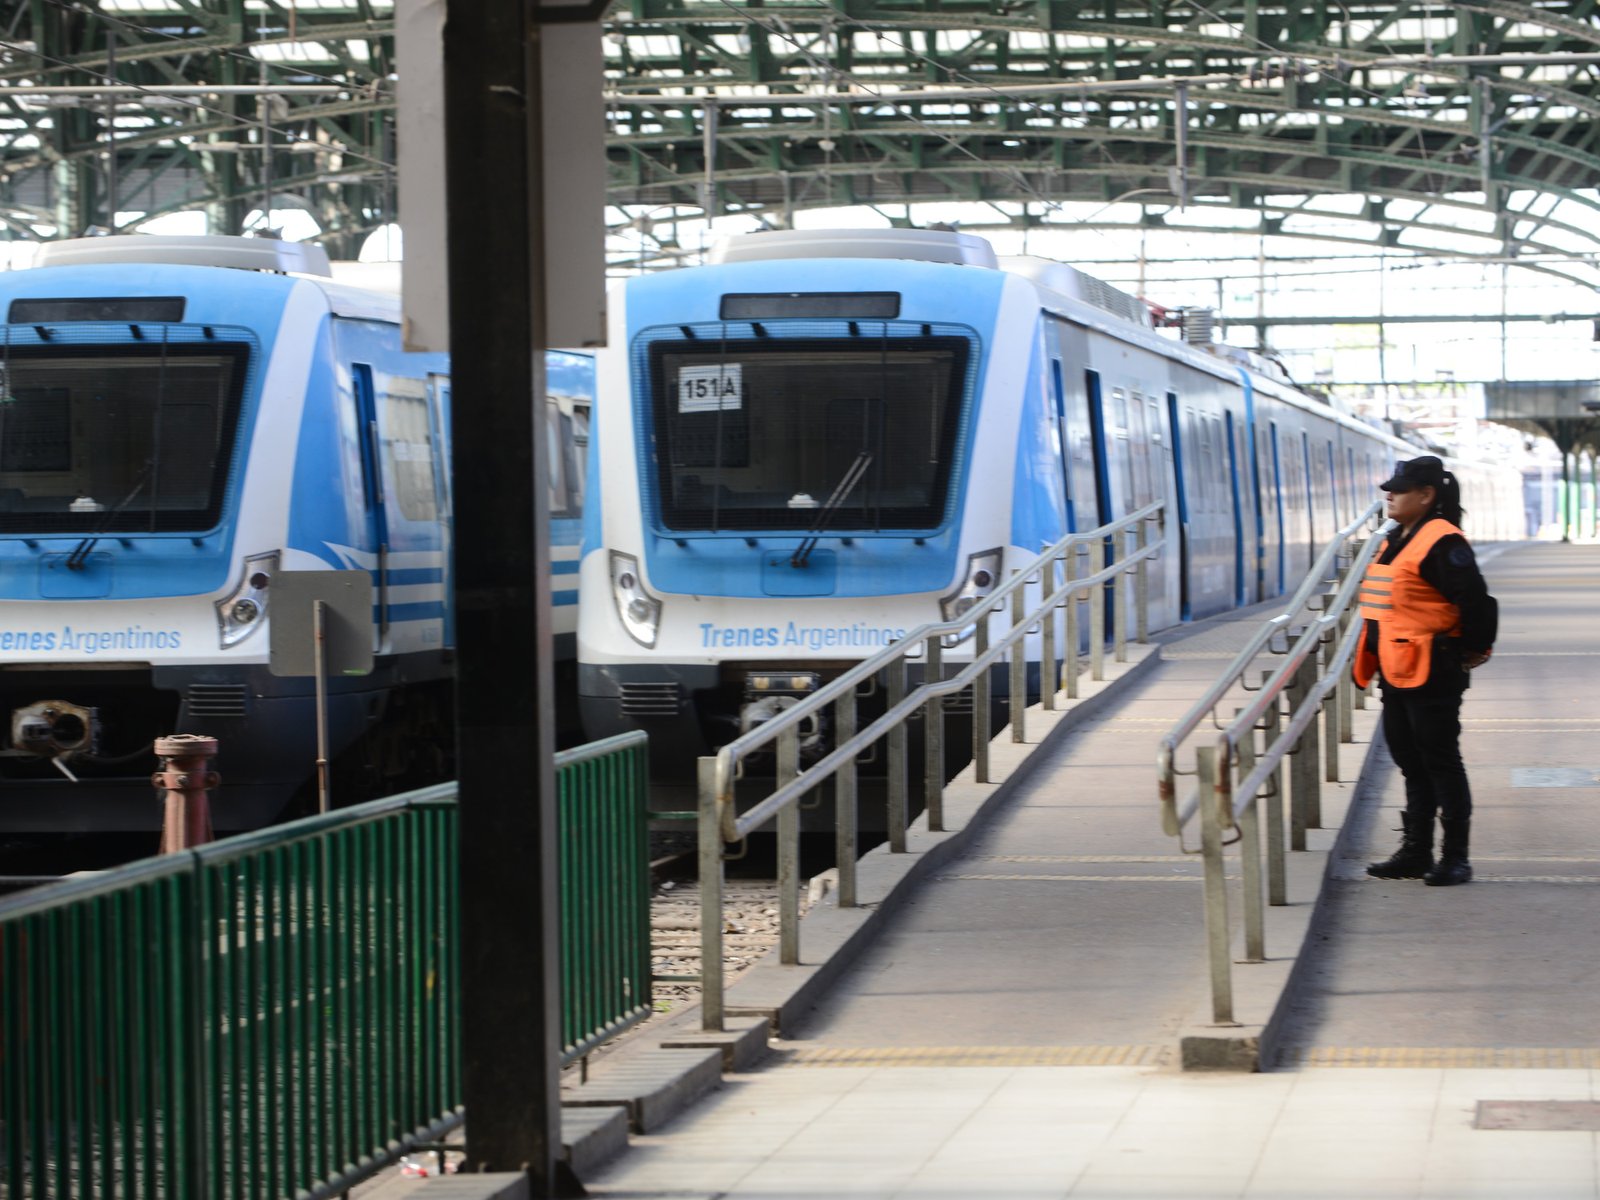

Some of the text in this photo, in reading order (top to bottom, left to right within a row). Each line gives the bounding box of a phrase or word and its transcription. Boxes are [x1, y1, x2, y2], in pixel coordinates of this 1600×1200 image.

[685, 377, 737, 399] 151A
[0, 625, 181, 654] enes Argentinos
[699, 621, 907, 650] Trenes Argentinos
